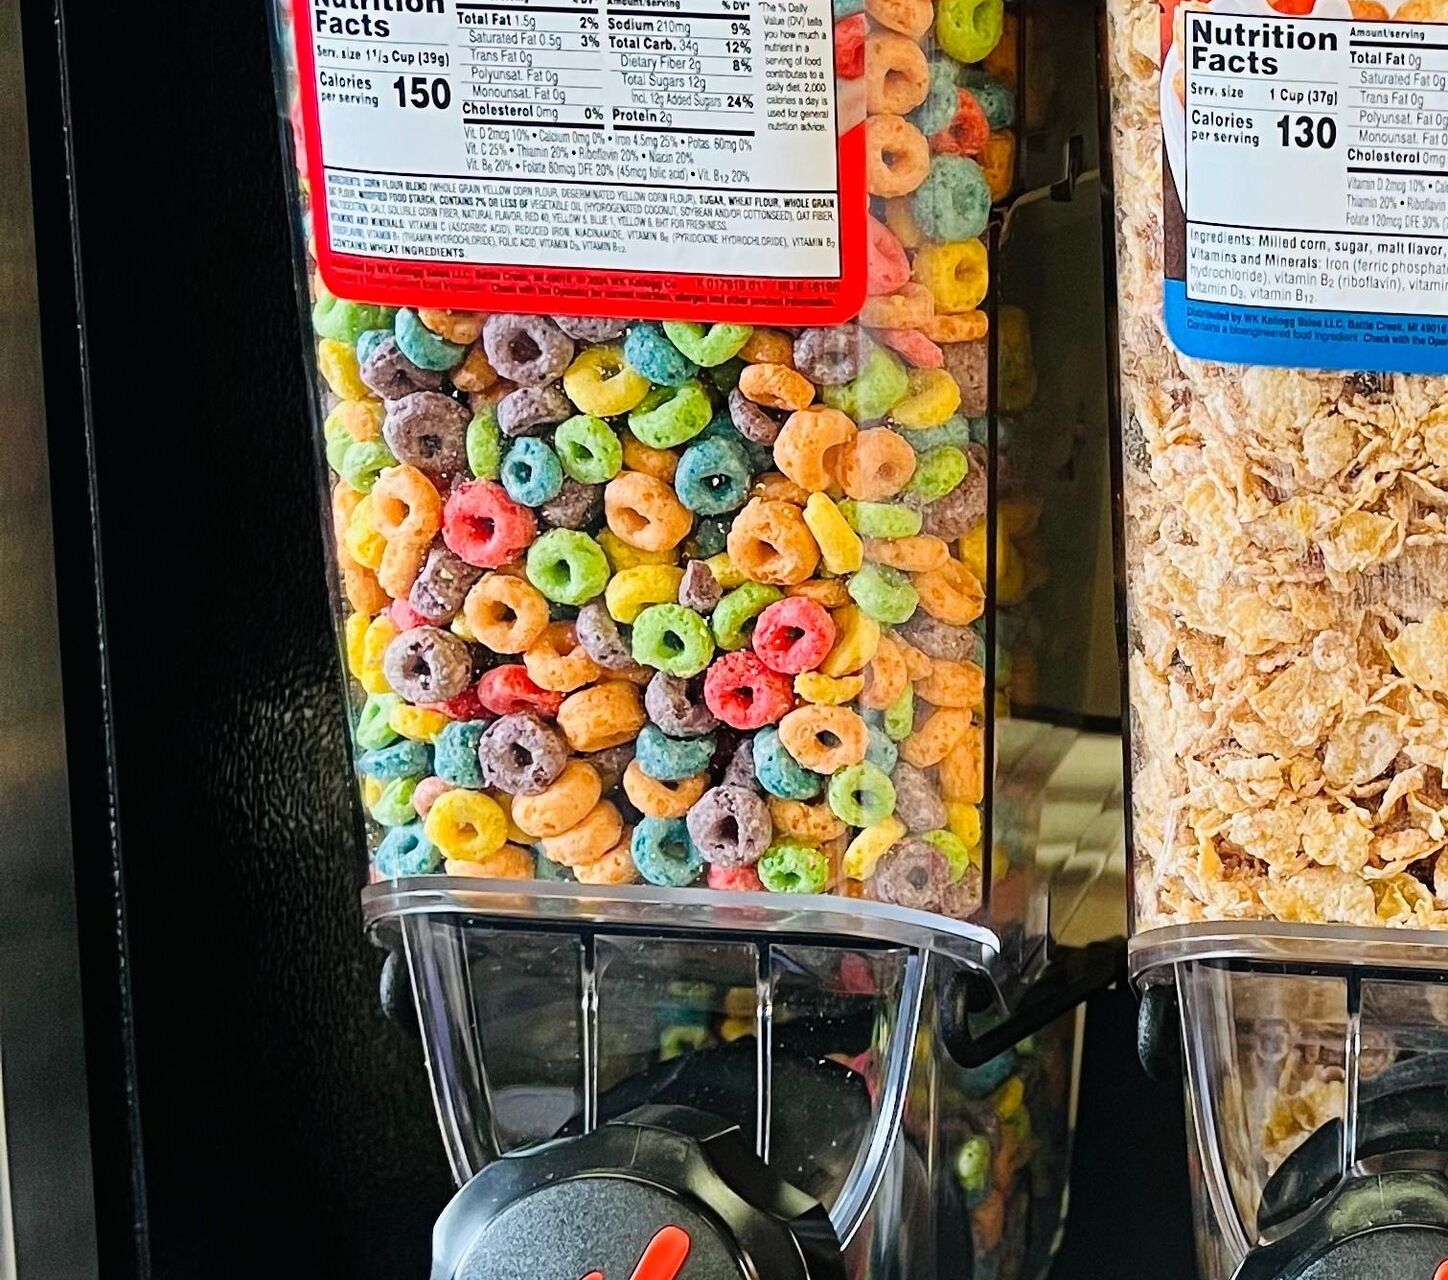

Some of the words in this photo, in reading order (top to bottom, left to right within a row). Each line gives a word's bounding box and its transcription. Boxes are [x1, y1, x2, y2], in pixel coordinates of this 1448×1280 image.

[316, 9, 391, 37] Facts
[456, 12, 488, 26] Total
[492, 13, 512, 27] Fat
[580, 17, 599, 30] 2%
[607, 18, 654, 32] Sodium
[731, 23, 751, 36] 9%
[1192, 19, 1337, 51] Nutrition
[609, 36, 641, 49] Total
[643, 37, 677, 51] Carb.
[725, 41, 752, 54] 12%
[391, 46, 415, 67] Cup
[418, 50, 450, 68] (39g)
[1192, 46, 1279, 75] Facts
[1350, 51, 1382, 65] Total
[1386, 53, 1405, 66] Fat
[319, 73, 372, 91] Calories
[321, 91, 337, 106] per
[338, 92, 379, 108] serving
[394, 76, 451, 109] 150
[727, 95, 754, 109] 24%
[1190, 82, 1218, 97] Serv.
[1221, 85, 1244, 98] size
[1280, 88, 1304, 104] Cup
[1307, 90, 1338, 106] (37g)
[462, 102, 534, 117] Cholesterol
[584, 107, 604, 121] 0%
[1191, 110, 1254, 129] Calories
[1191, 130, 1210, 142] per
[1214, 130, 1260, 148] serving
[1277, 115, 1337, 149] 130
[1347, 148, 1420, 164] Cholesterol
[1190, 227, 1255, 247] Ingredients:
[1258, 234, 1297, 249] Milled
[1300, 238, 1331, 252] corn,
[1334, 240, 1372, 255] sugar,
[1377, 241, 1406, 255] malt
[1408, 242, 1447, 258] flavor,
